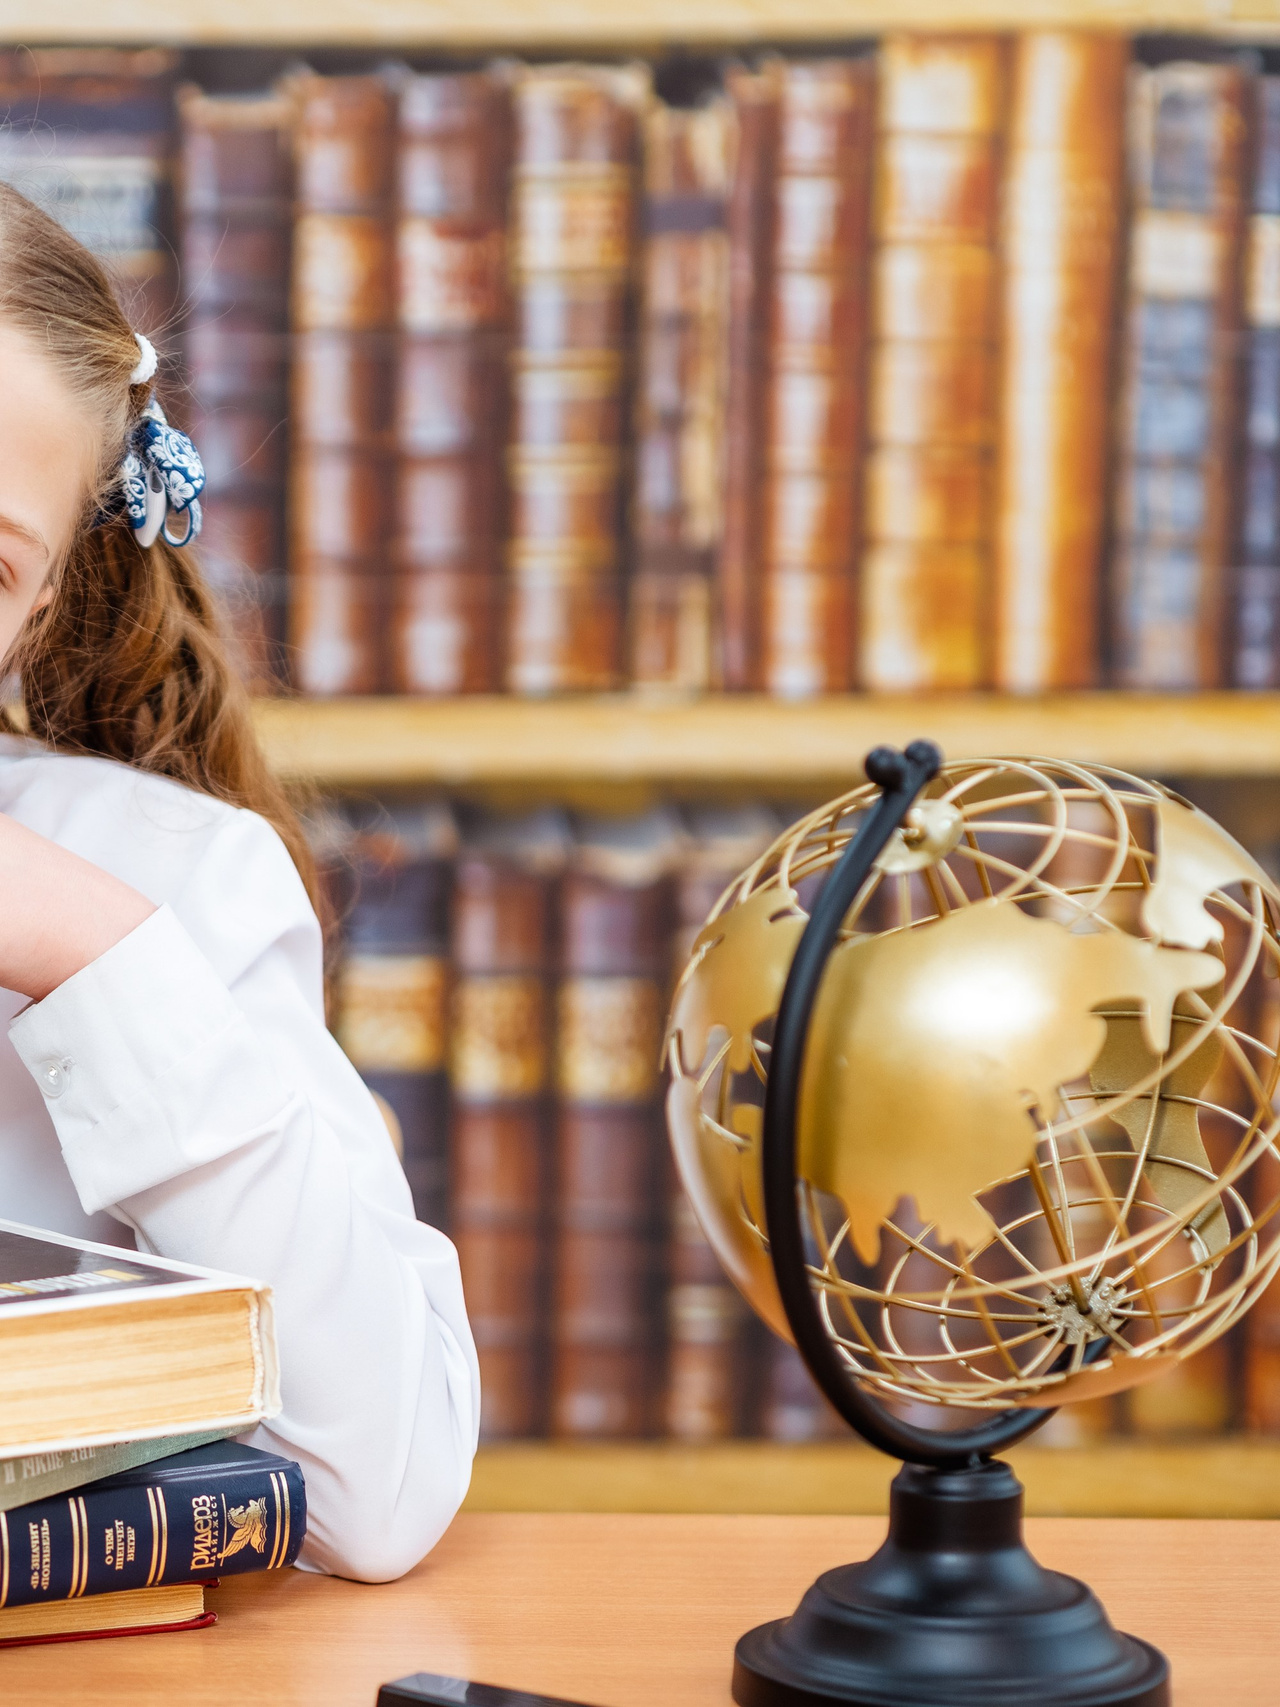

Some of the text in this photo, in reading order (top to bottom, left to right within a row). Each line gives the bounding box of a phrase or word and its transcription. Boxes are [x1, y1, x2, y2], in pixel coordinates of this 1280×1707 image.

[3, 1461, 16, 1484] И
[29, 1522, 40, 1571] ЗНАЧИТ
[41, 1518, 51, 1591] «ПОГИБЕЛЬ»
[105, 1528, 114, 1566] О ЧЕМ
[115, 1519, 125, 1571] ШЕПЧЕТ
[126, 1526, 136, 1562] ВЕТЕР
